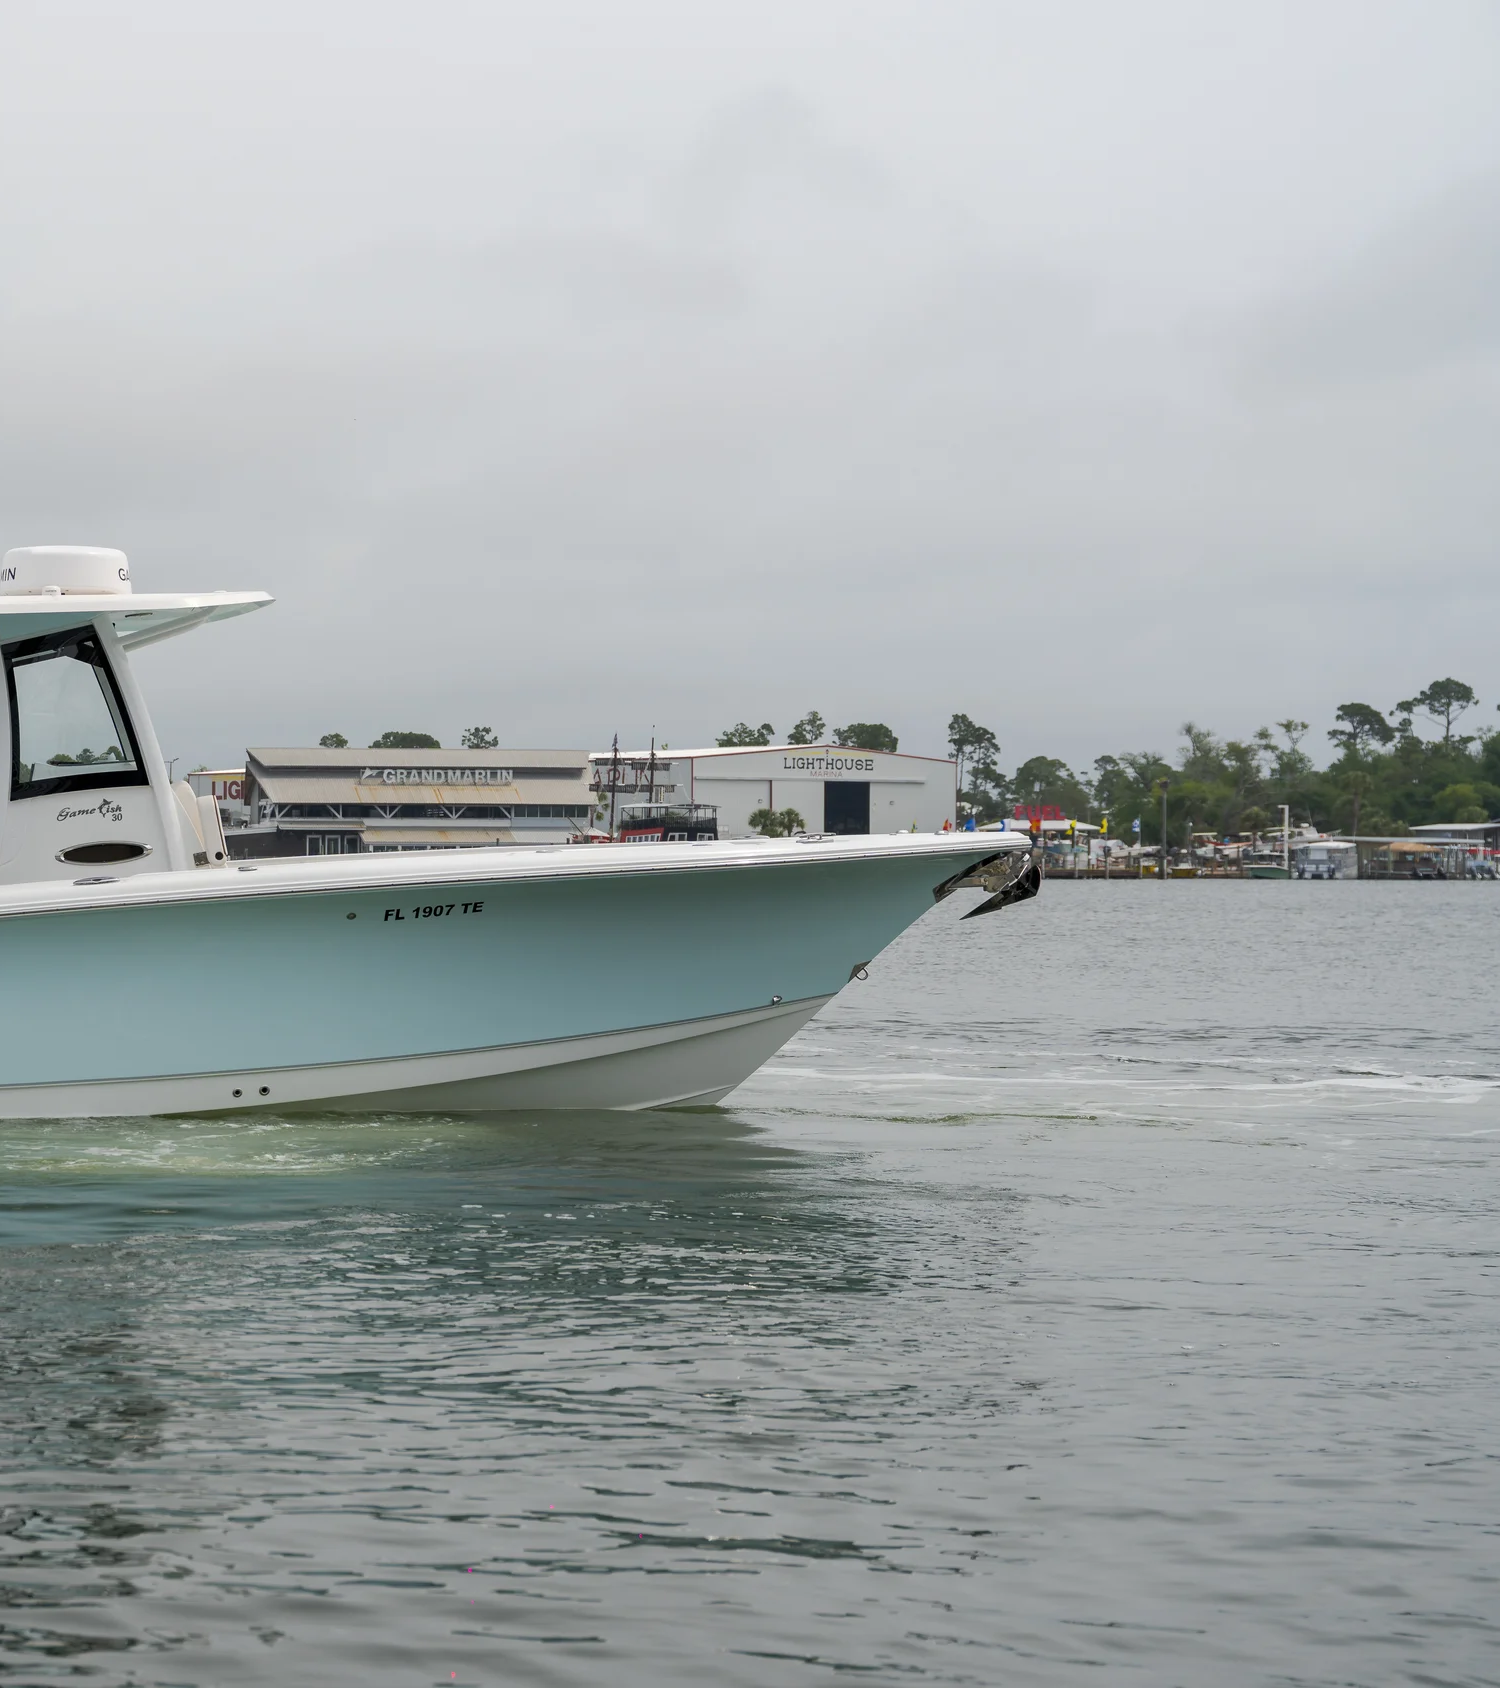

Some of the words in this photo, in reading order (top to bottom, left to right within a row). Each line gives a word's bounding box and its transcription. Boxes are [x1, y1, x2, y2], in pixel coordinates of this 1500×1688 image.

[783, 757, 874, 771] LIGHTHOUSE
[810, 770, 843, 778] MARINA
[111, 813, 123, 822] 30
[1014, 805, 1066, 821] FUEL
[384, 908, 405, 921] FL
[412, 904, 455, 919] 1907
[461, 901, 484, 914] TE
